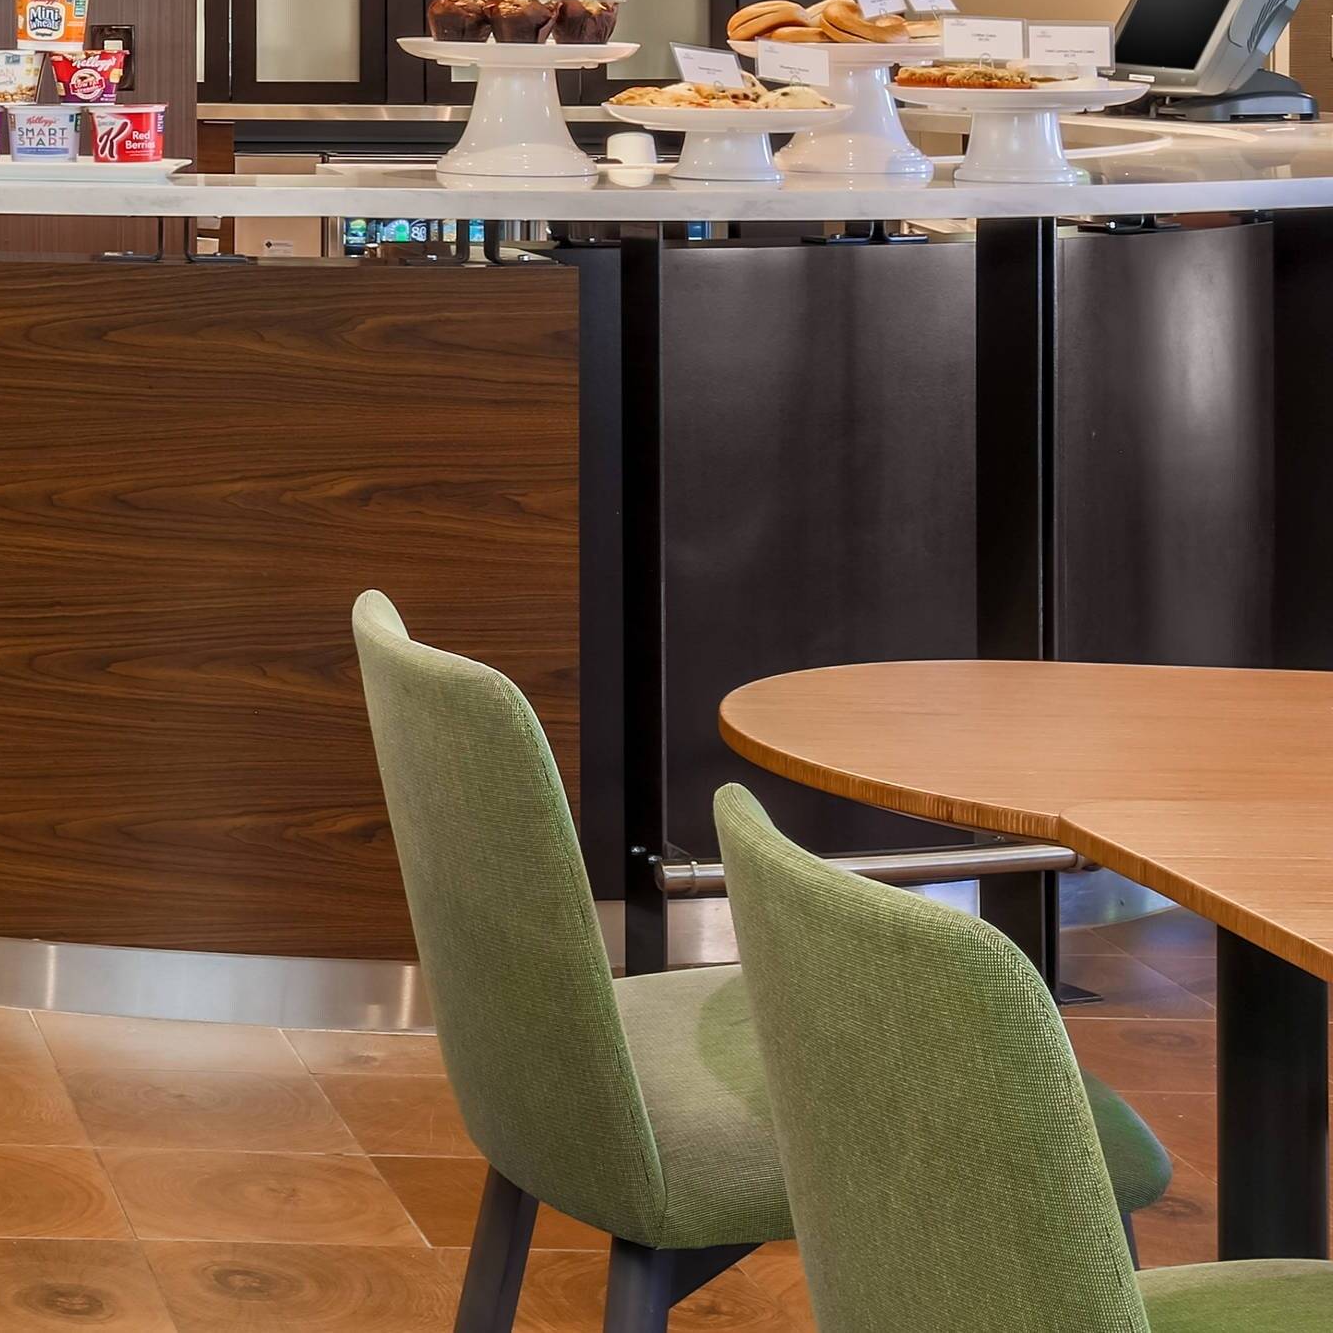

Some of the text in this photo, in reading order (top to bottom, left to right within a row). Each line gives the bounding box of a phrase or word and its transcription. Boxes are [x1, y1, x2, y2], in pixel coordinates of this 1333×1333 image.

[18, 127, 68, 137] SMART
[132, 130, 151, 141] Red
[18, 137, 69, 147] START
